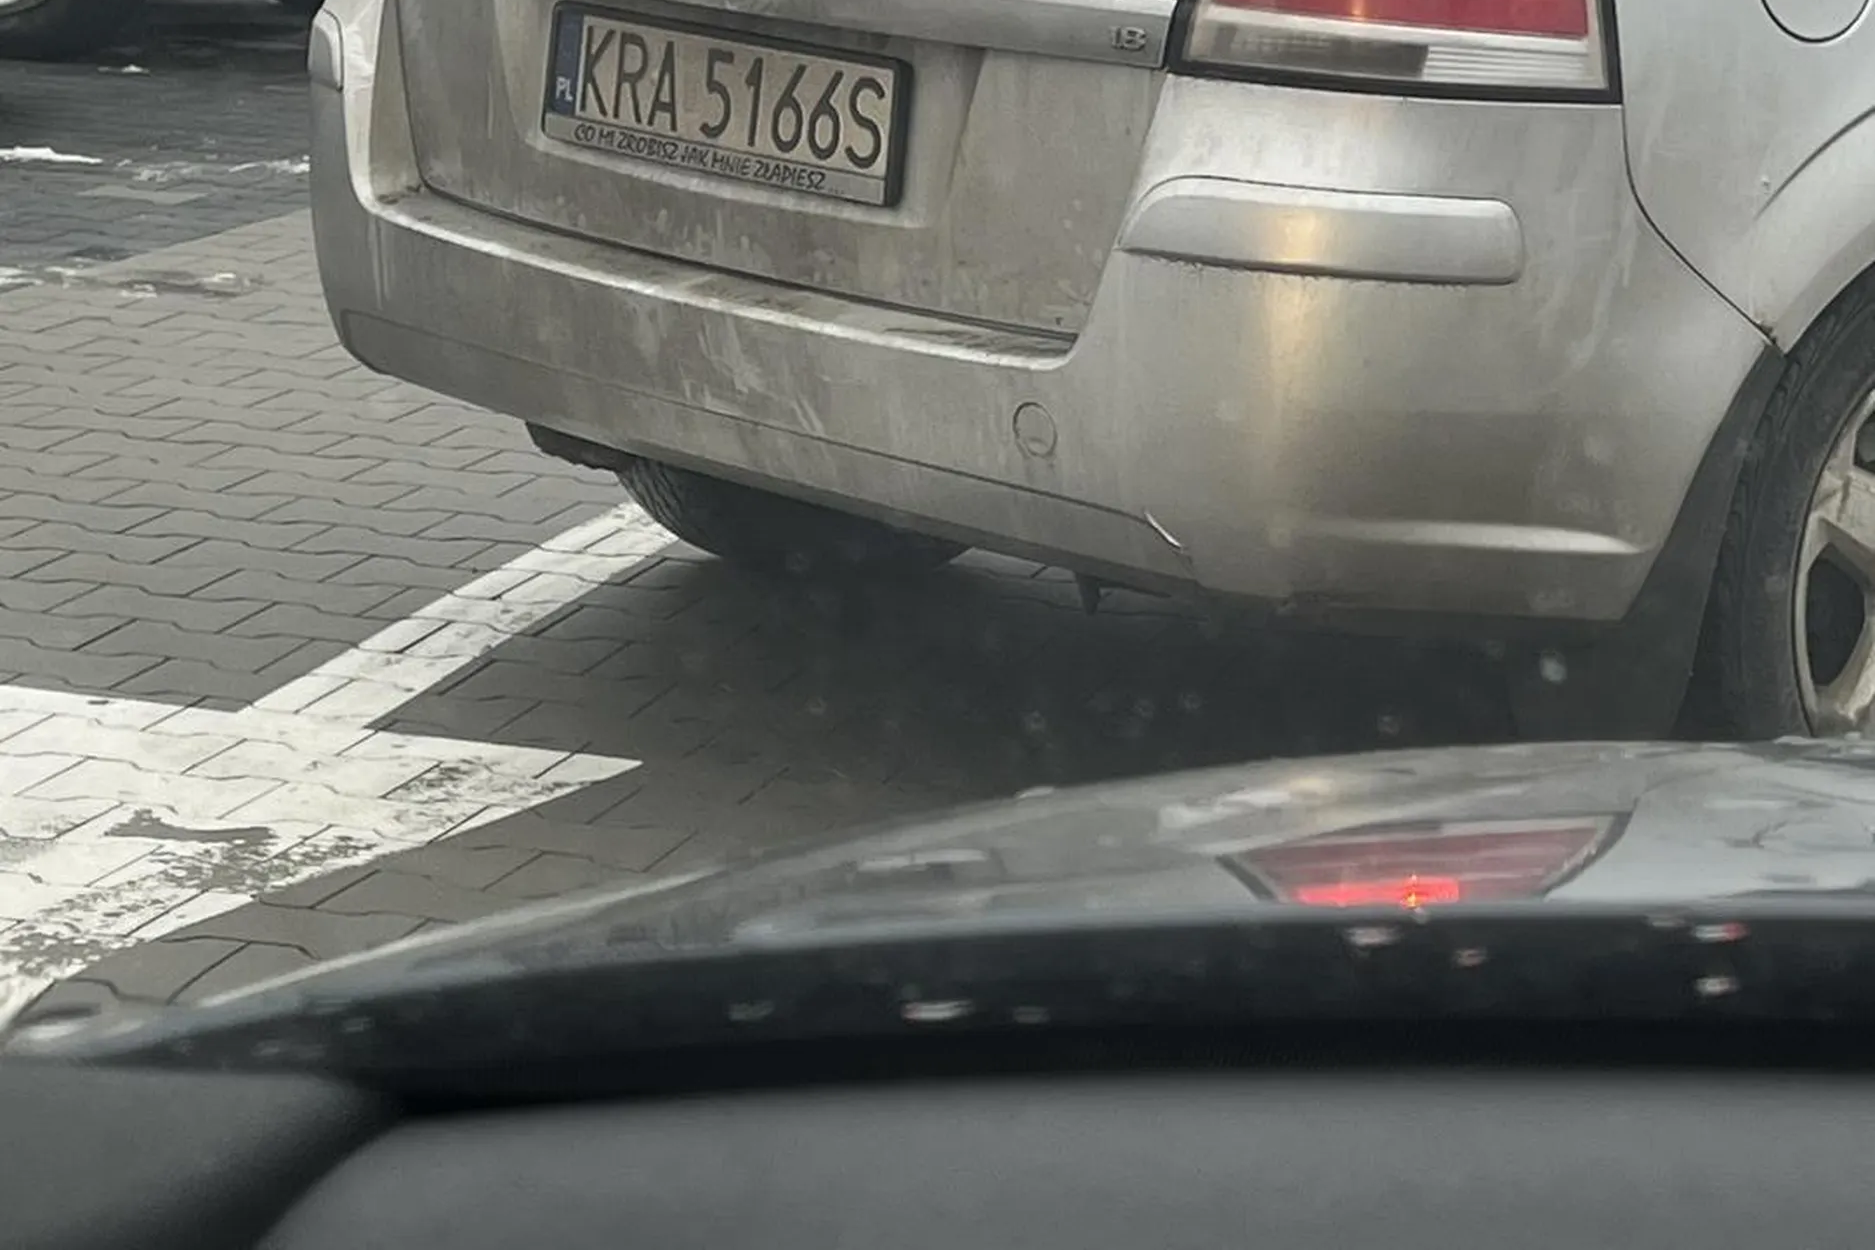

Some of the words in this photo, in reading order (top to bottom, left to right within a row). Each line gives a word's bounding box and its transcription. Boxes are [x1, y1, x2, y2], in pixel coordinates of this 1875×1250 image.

[556, 77, 573, 101] PL
[580, 25, 678, 132] KRA
[699, 48, 886, 168] 5166S
[574, 123, 596, 142] CO
[600, 129, 615, 146] MI
[616, 133, 679, 159] ZROBISZ
[681, 145, 711, 165] JAK
[711, 151, 750, 176] MNIE
